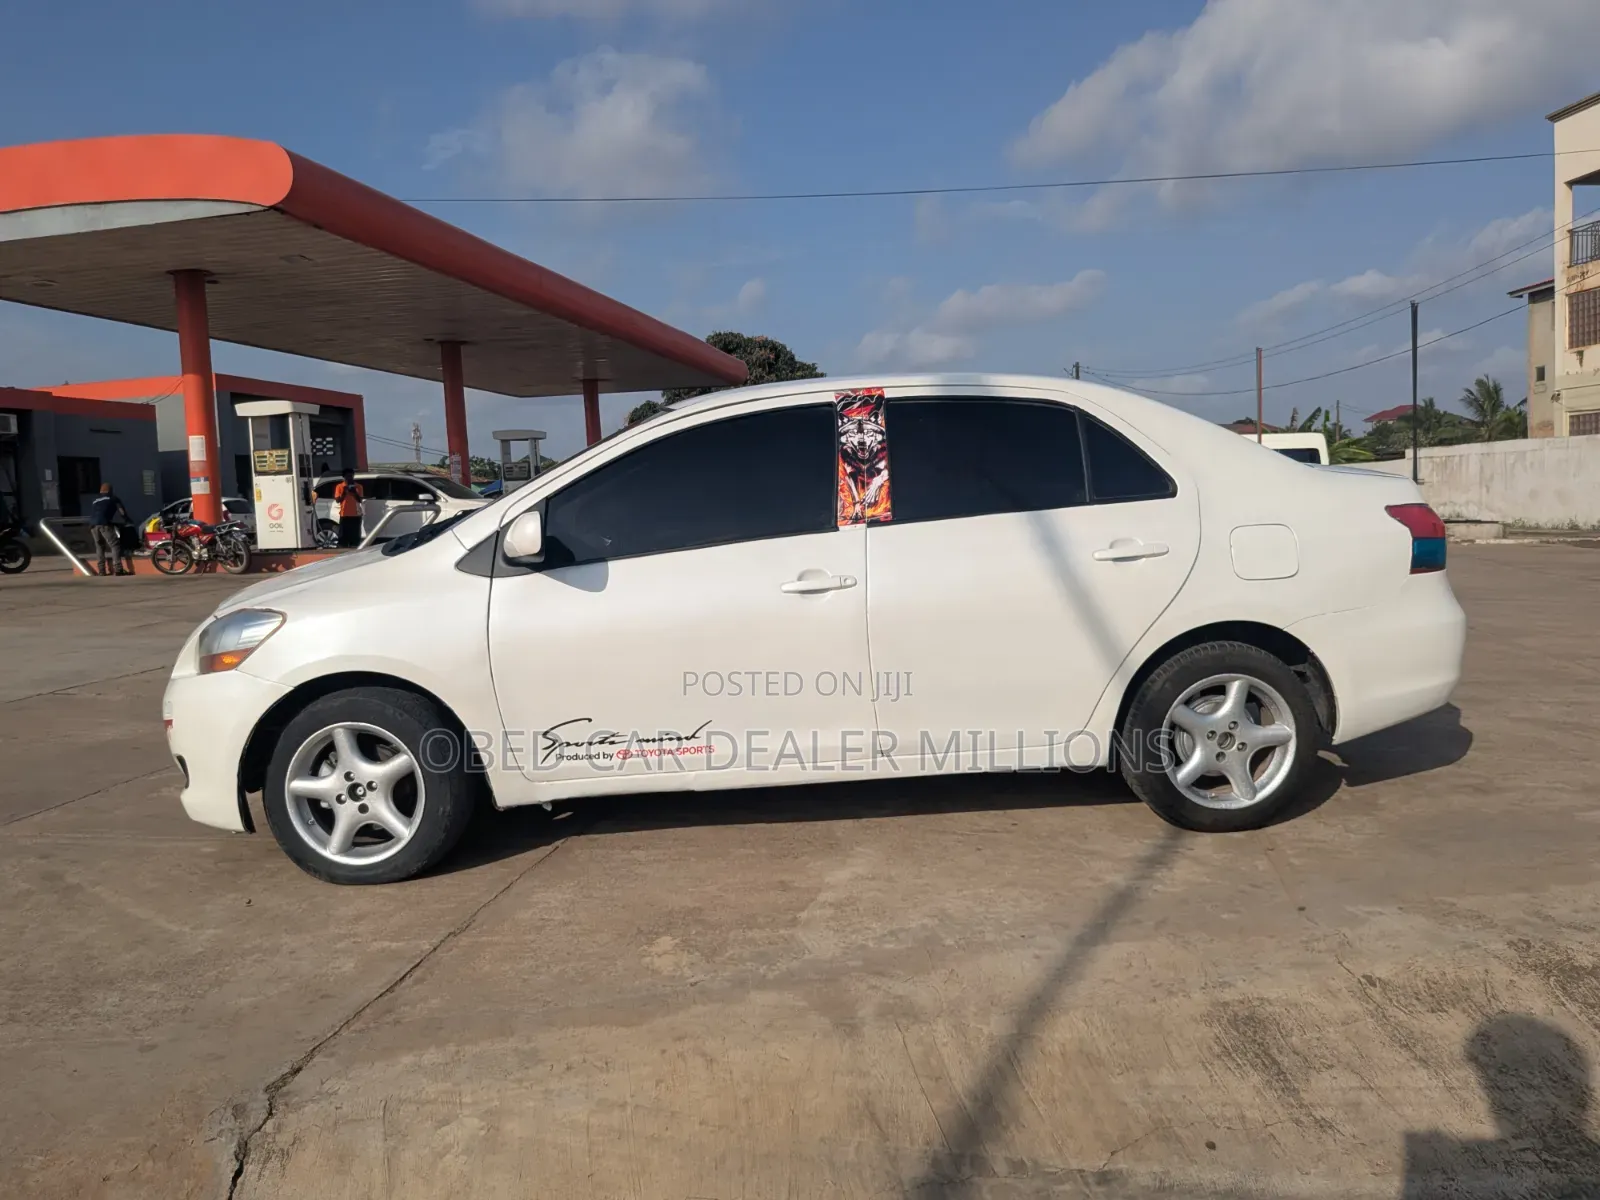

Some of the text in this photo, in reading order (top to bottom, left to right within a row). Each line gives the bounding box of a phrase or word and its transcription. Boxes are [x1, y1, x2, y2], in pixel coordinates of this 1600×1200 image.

[555, 744, 716, 762] Produced by TOYOTA SPORTS
